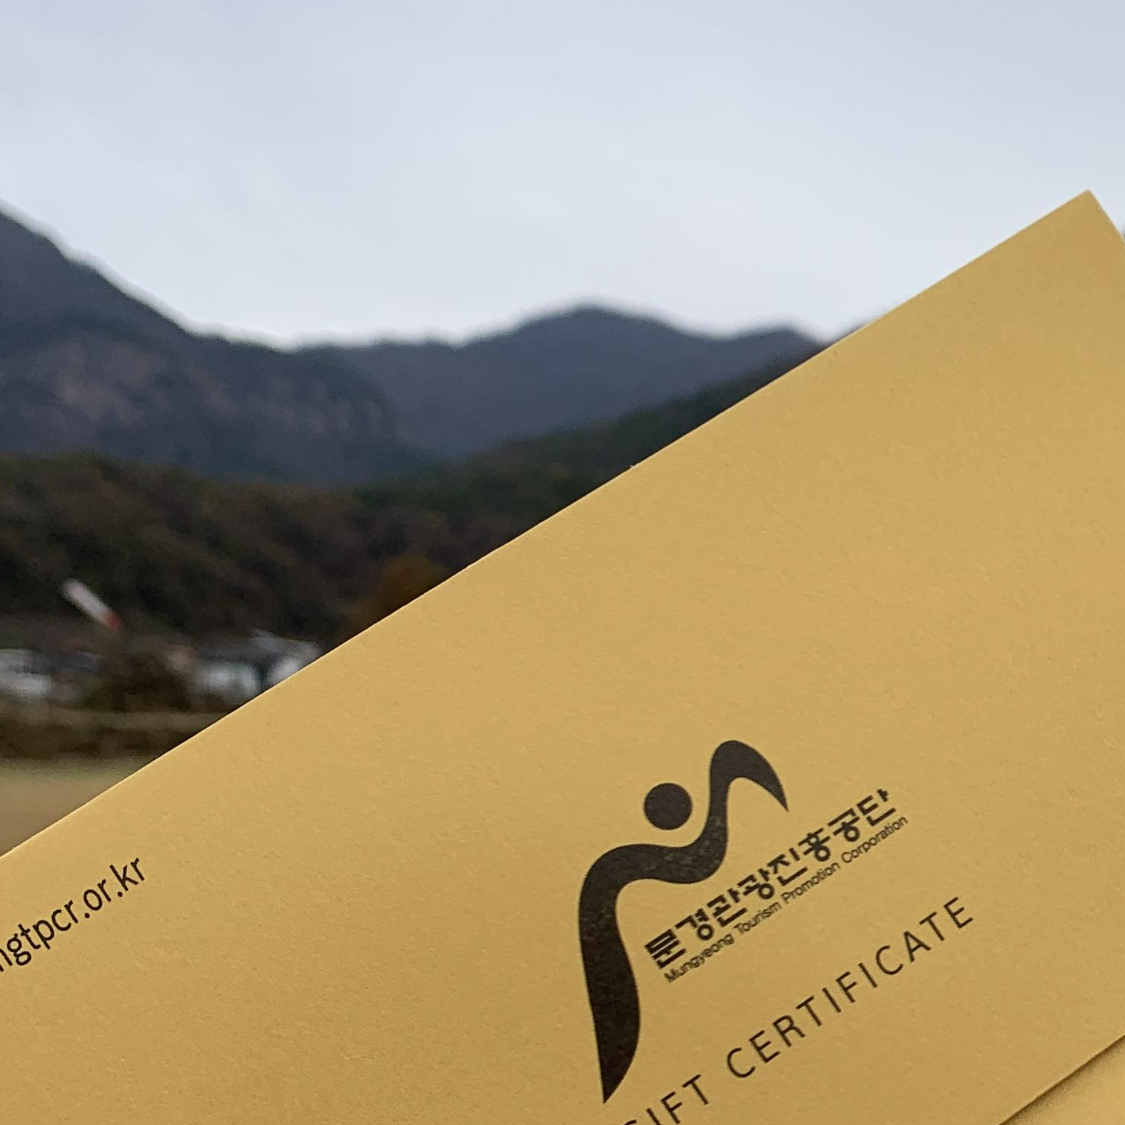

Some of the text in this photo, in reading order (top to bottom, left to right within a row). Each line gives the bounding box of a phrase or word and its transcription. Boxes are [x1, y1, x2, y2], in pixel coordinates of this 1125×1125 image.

[645, 789, 896, 969] 문경관광진흥공단
[664, 816, 909, 983] Mungyeong Tourism Promotion Corporation
[726, 896, 974, 1079] CERTIFICATE
